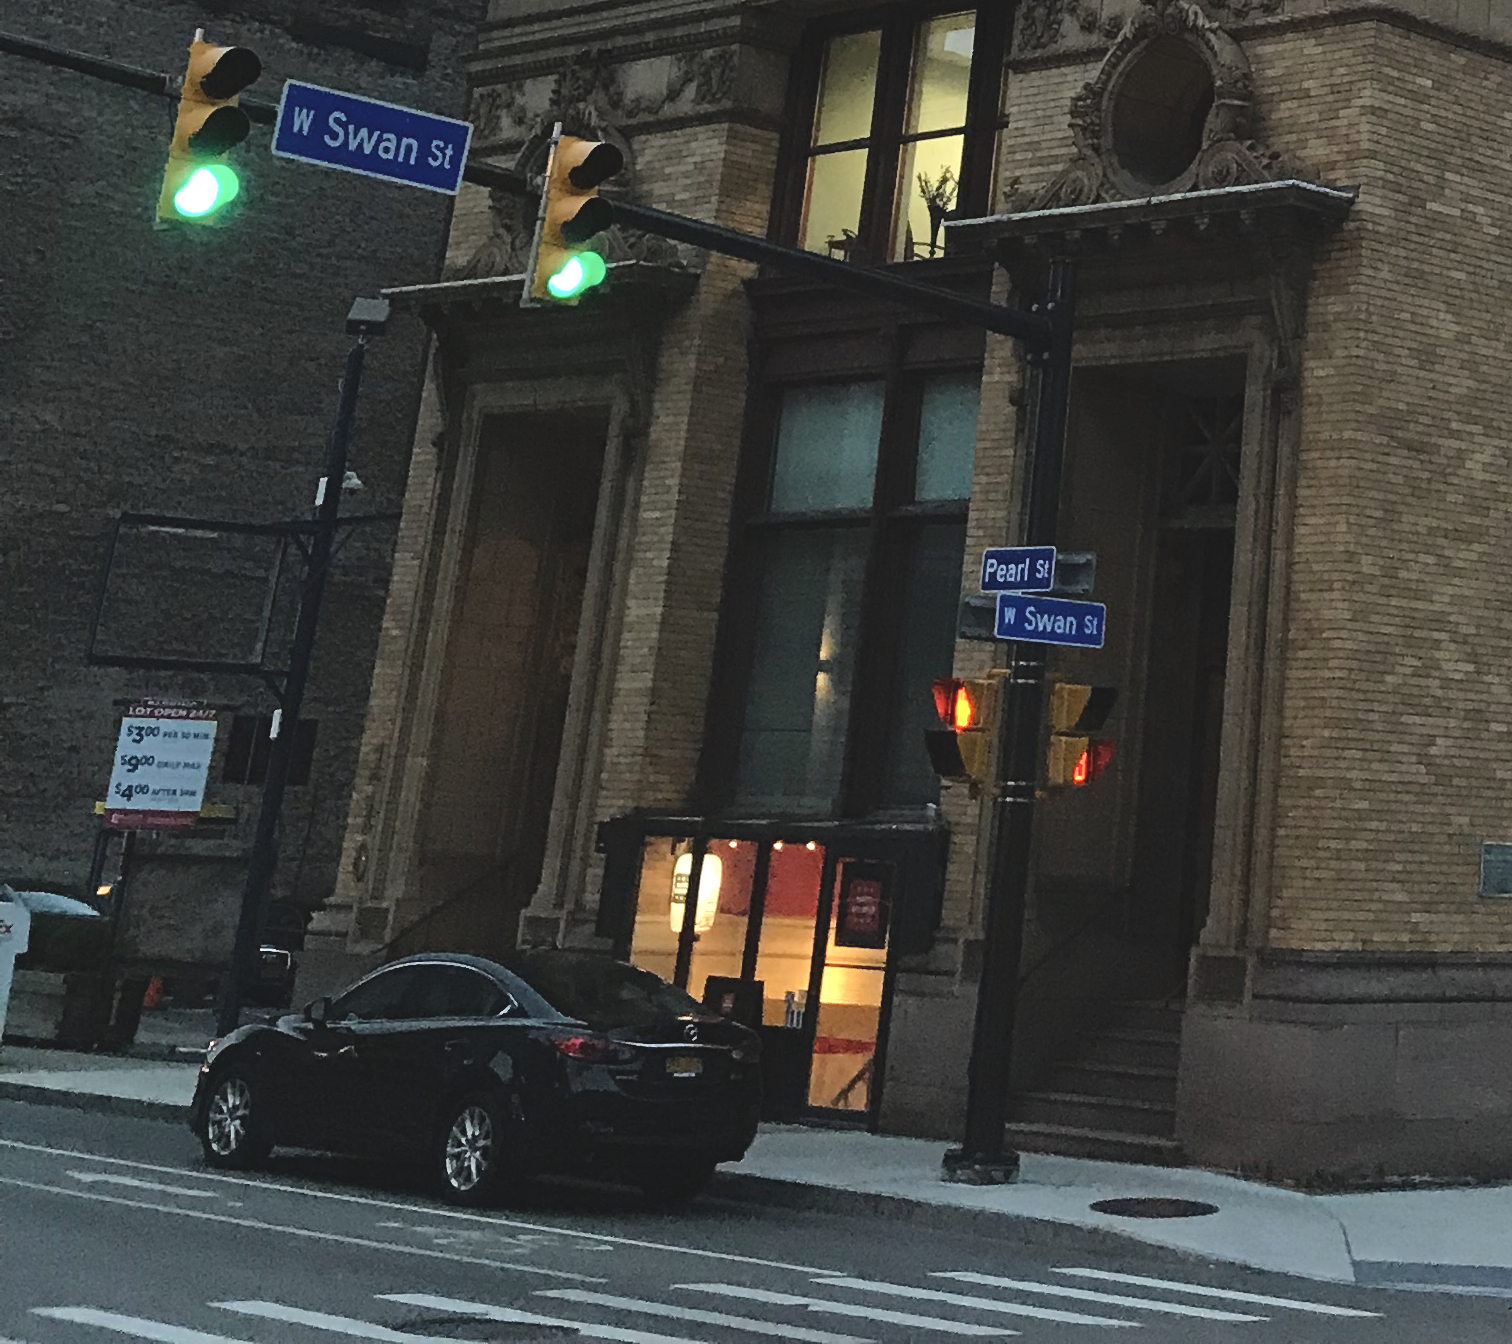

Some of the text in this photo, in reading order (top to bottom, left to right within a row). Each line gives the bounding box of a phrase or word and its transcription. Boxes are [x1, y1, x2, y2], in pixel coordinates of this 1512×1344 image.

[293, 106, 453, 169] W Swan St
[985, 558, 1050, 582] Pearl St
[1004, 606, 1098, 635] W Swan St
[128, 707, 153, 716] LOT
